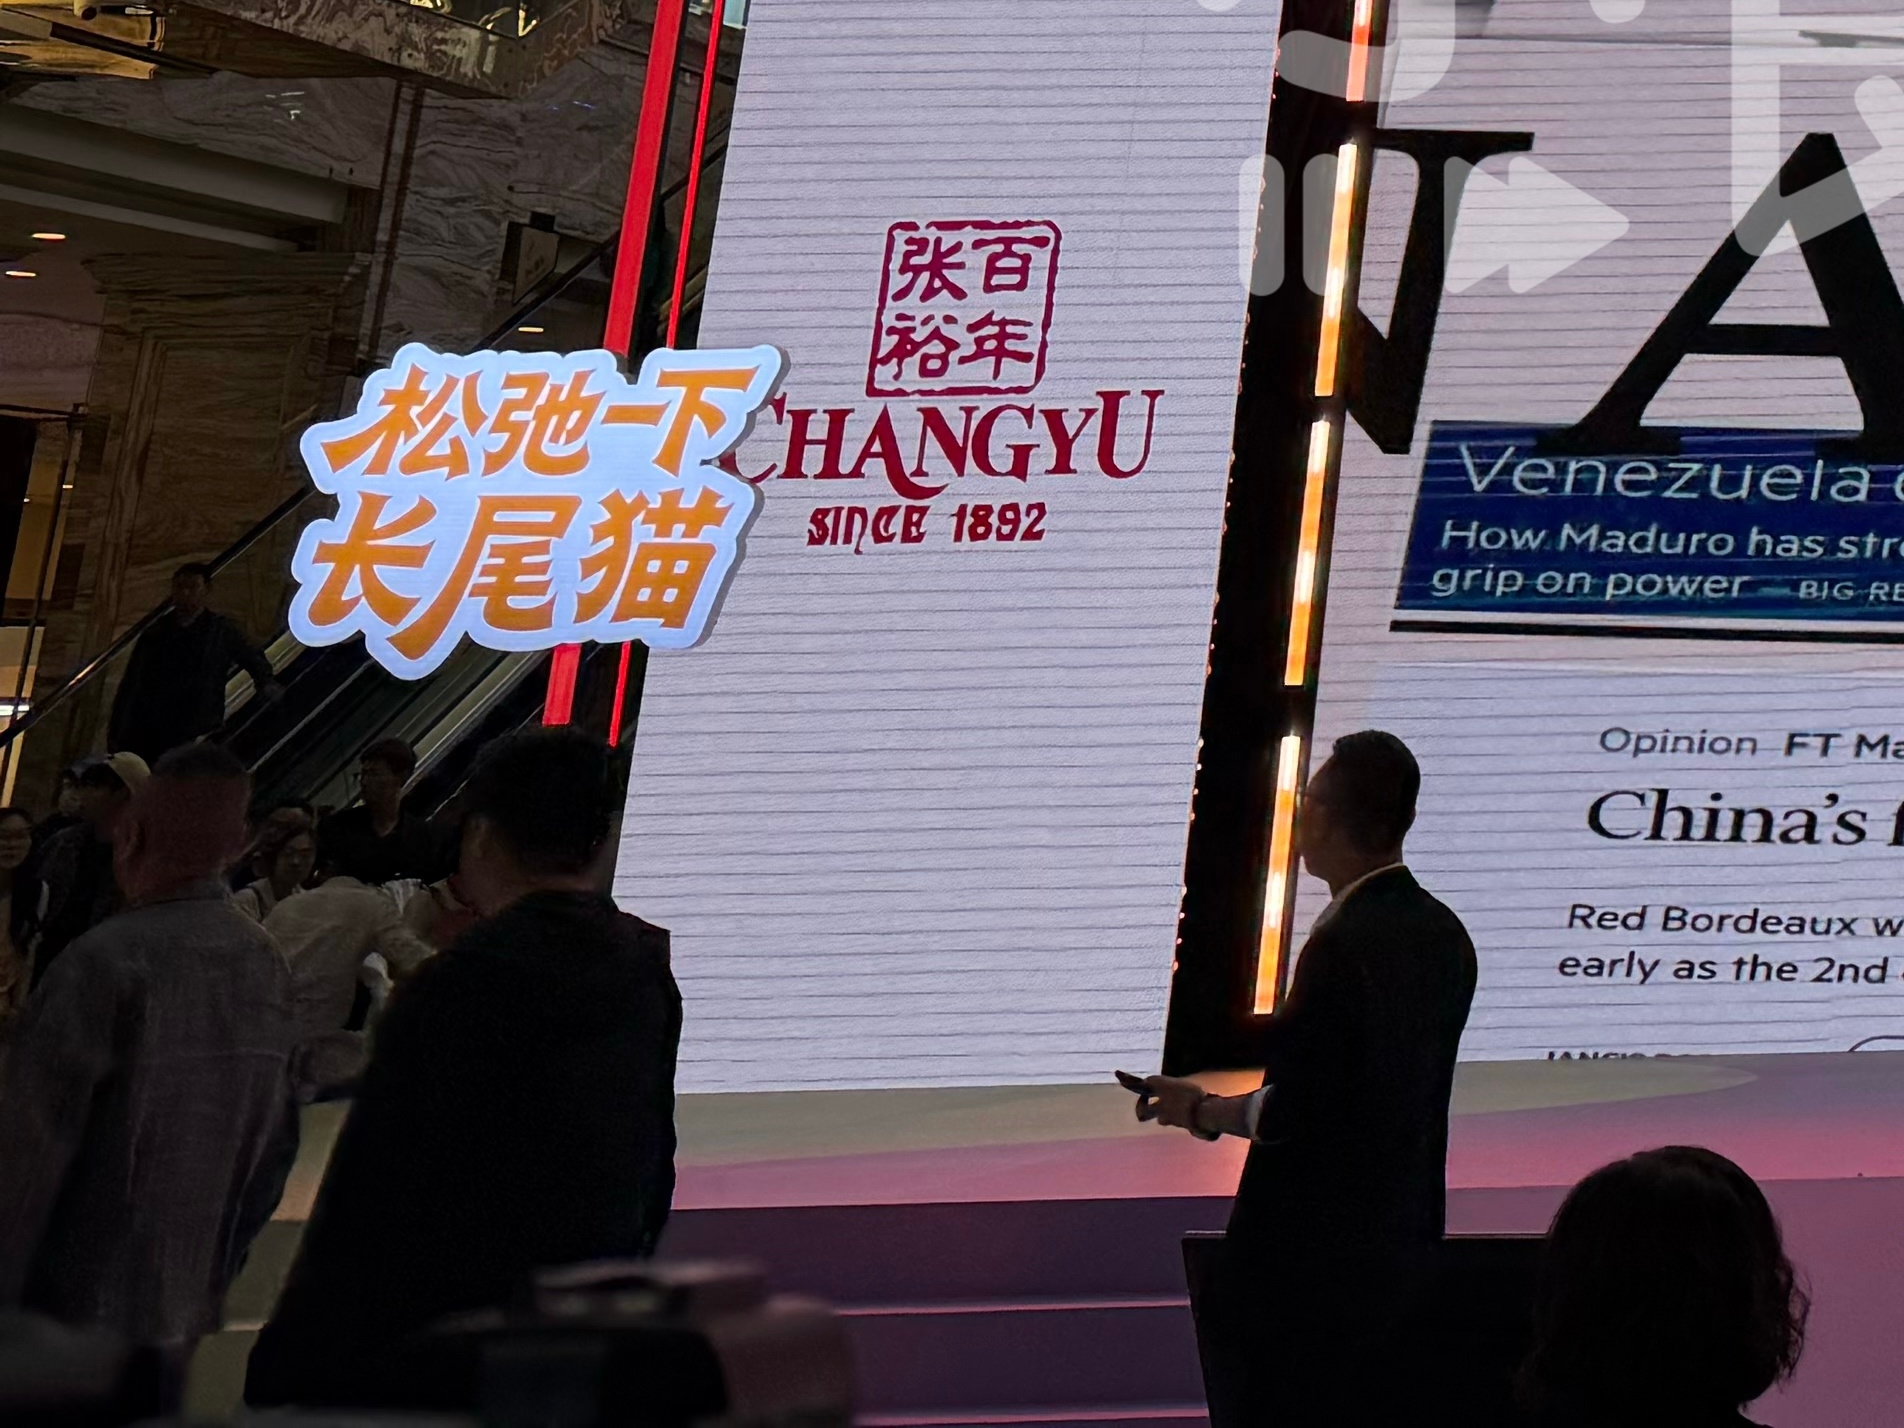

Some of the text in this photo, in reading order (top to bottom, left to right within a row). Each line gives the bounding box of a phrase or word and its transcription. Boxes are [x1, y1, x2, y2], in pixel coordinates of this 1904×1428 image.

[322, 362, 762, 480] 松弛一下
[718, 389, 1166, 501] CHANGYU
[1456, 440, 1872, 504] Venezuela
[806, 502, 1048, 556] SINCE 1892
[1441, 519, 1546, 552] How
[1560, 520, 1735, 558] Maduro
[1749, 525, 1825, 559] has
[305, 487, 734, 662] 长尾猫
[1430, 562, 1525, 602] grip
[1537, 571, 1593, 594] on
[1605, 572, 1752, 606] power
[1799, 580, 1855, 601] BIG
[1599, 727, 1759, 760] Opinion
[1784, 732, 1842, 758] FT
[1586, 787, 1869, 847] China’s
[1568, 903, 1647, 934] Red
[1661, 905, 1858, 940] Bordeaux
[1557, 952, 1657, 986] early
[1672, 957, 1718, 982] as
[1731, 952, 1798, 984] the
[1808, 955, 1889, 986] 2nd
